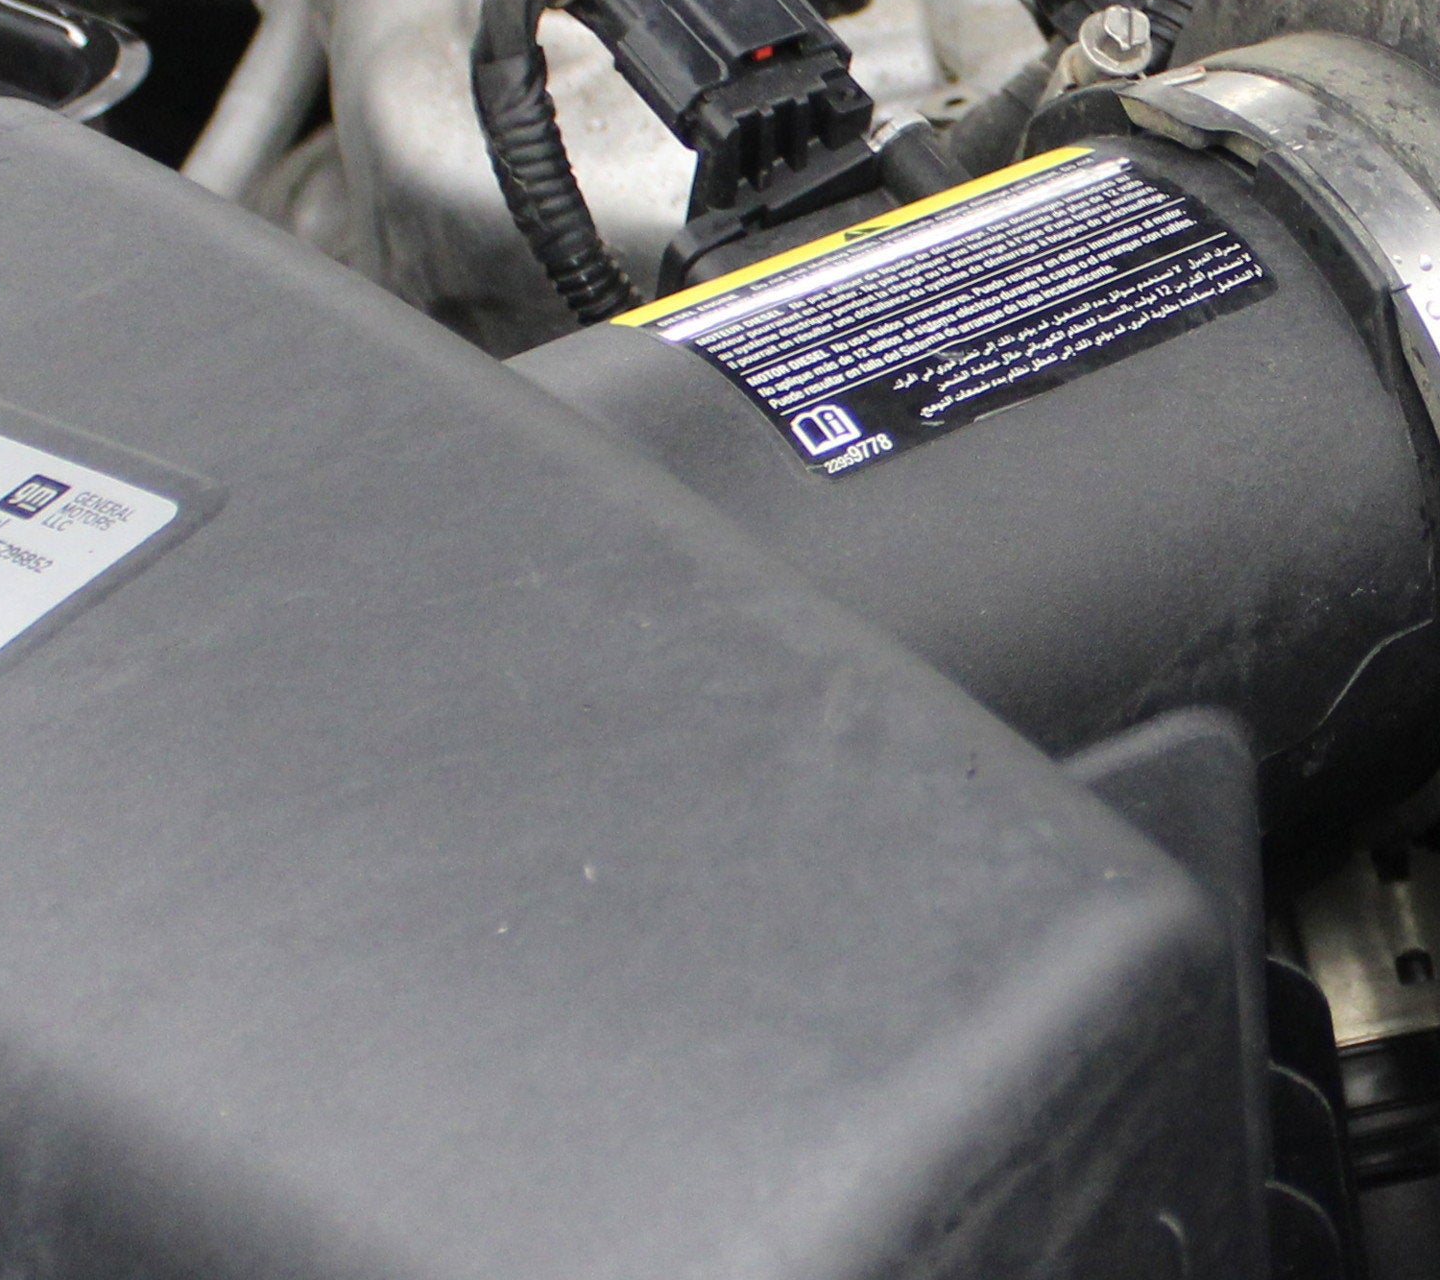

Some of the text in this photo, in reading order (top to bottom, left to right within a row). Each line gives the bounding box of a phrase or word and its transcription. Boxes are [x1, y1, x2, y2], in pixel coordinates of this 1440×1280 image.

[746, 364, 789, 386] MOTOR
[787, 348, 829, 370] DIESEL
[830, 341, 848, 353] No
[847, 334, 869, 346] use
[867, 319, 903, 338] fluidos
[902, 291, 976, 324] arrancadores.
[973, 278, 1006, 296] Puede
[1004, 263, 1045, 284] resultar
[1045, 258, 1060, 268] en
[1141, 220, 1154, 229] al
[1152, 207, 1188, 225] motor.
[758, 385, 775, 397] No
[774, 370, 815, 392] aplique
[812, 360, 838, 375] más
[837, 354, 854, 365] de
[853, 348, 869, 359] 12
[867, 334, 903, 353] voltios
[901, 329, 915, 340] al
[912, 313, 957, 335] sistema
[955, 295, 1001, 318] eléctrico
[999, 279, 1041, 300] durante
[1038, 275, 1050, 285] la
[1050, 265, 1081, 282] carga
[1086, 256, 1099, 265] el
[1099, 240, 1144, 262] arranque
[1142, 232, 1162, 243] con
[1160, 217, 1199, 236] cables.
[1157, 284, 1175, 297] 12
[695, 324, 742, 346] MOTEUR
[742, 308, 782, 328] DIESEL
[768, 389, 803, 409] Puede
[801, 372, 845, 396] resultar
[844, 368, 860, 379] en
[857, 357, 883, 373] falla
[881, 350, 901, 363] del
[899, 332, 946, 356] Sistema
[943, 327, 959, 338] de
[958, 310, 1006, 334] arranque
[1001, 303, 1018, 314] de
[1040, 264, 1117, 299] incandescente.
[824, 433, 893, 473] 22959778
[1, 480, 64, 515] gm
[72, 491, 138, 522] GENERAL
[40, 514, 74, 532] LLC
[56, 503, 117, 532] MOTORS
